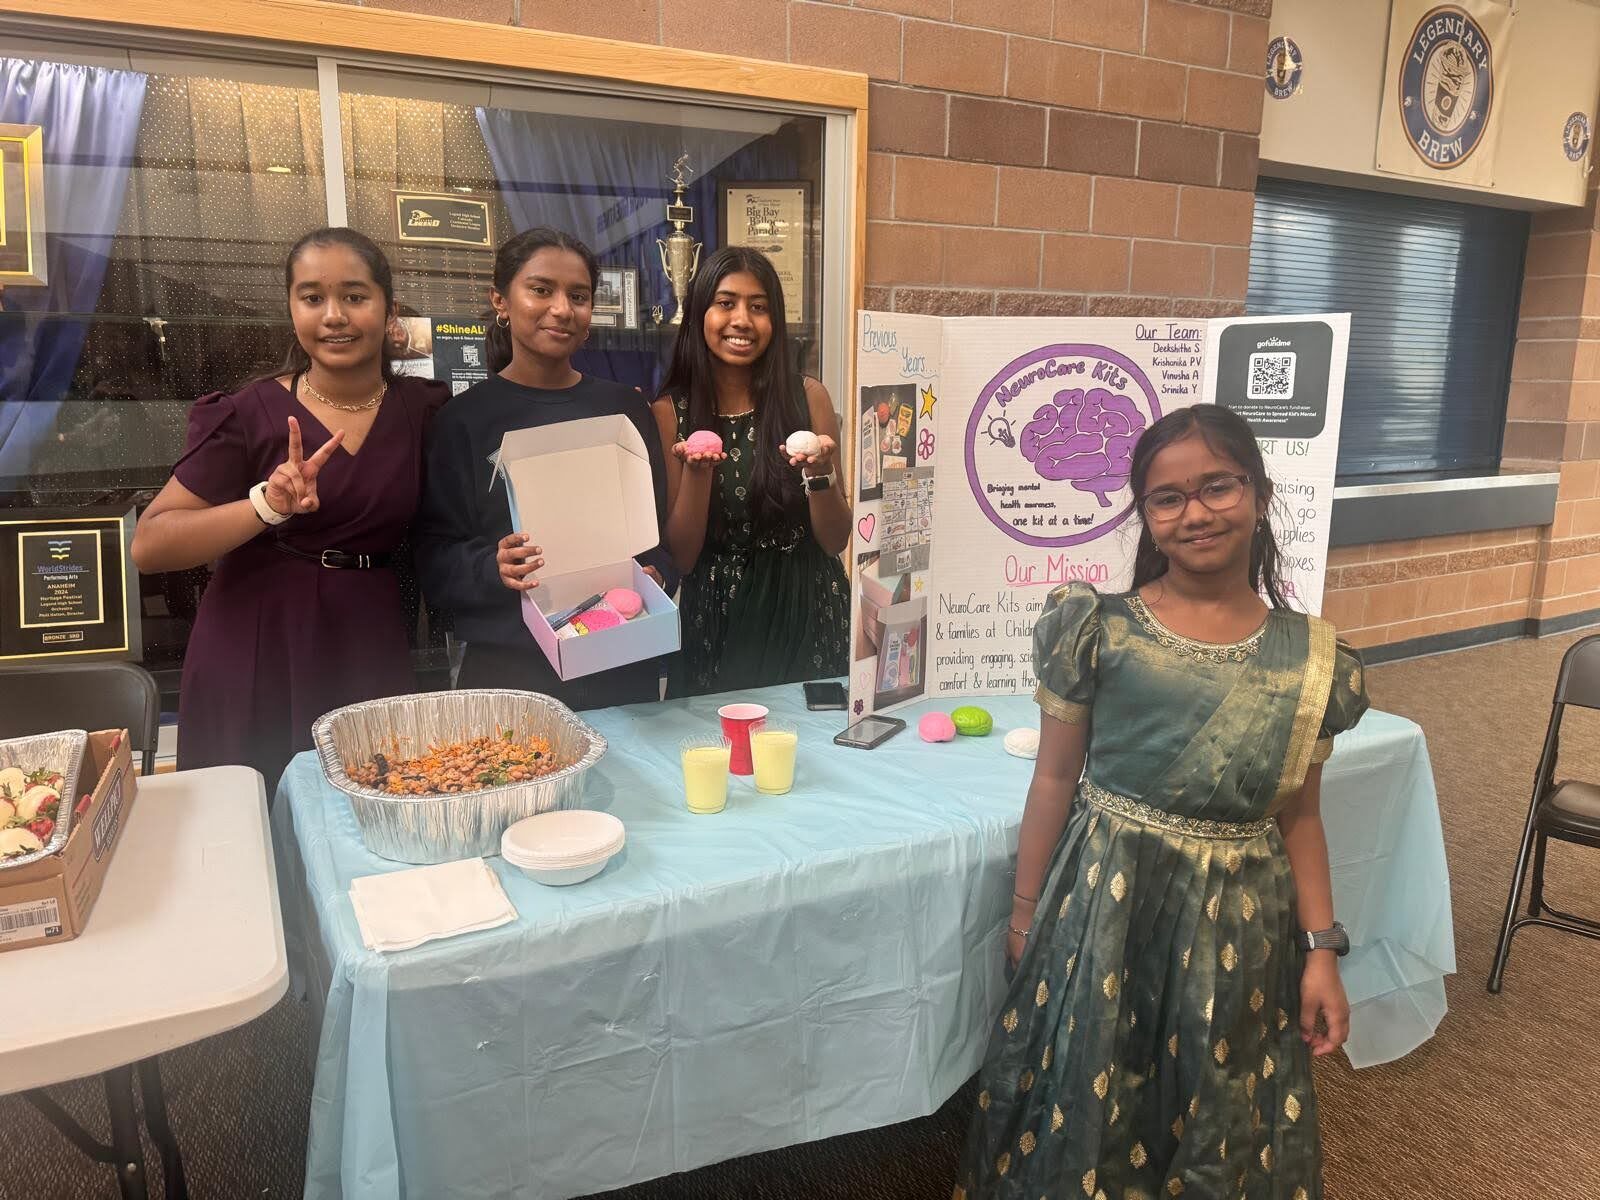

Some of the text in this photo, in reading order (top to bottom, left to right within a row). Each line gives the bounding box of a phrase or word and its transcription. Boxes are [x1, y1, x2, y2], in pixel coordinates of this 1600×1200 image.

[1413, 17, 1488, 70] LEGENDARY
[1274, 81, 1293, 97] BREW
[1417, 130, 1463, 163] BREW
[746, 206, 780, 219] Big Bay
[407, 218, 441, 227] LEGEND
[747, 225, 780, 236] Parade
[436, 325, 486, 335] #ShineALi
[863, 313, 897, 348] Previous
[1135, 323, 1203, 339] Our Team:
[1194, 342, 1200, 353] S
[1256, 338, 1292, 349] gofundme
[1162, 370, 1199, 380] Vinusha A
[995, 358, 1128, 408] NeuroCare Kits
[1161, 383, 1198, 394] Srinika Y
[1286, 441, 1310, 456] US!
[987, 483, 1040, 496] Bringing mental
[1000, 500, 1021, 509] health
[1012, 513, 1095, 526] one kit at a time!
[1297, 507, 1317, 525] go
[1274, 526, 1316, 546] upplies
[37, 564, 84, 573] WorldStrides
[1005, 553, 1109, 584] Our Mission
[939, 592, 991, 615] NeuroCare
[997, 591, 1020, 613] Kits
[935, 619, 1034, 640] & families at Childr
[936, 648, 975, 672] providing
[939, 672, 967, 691] comfort
[973, 671, 983, 689] &
[986, 671, 1017, 693] learning
